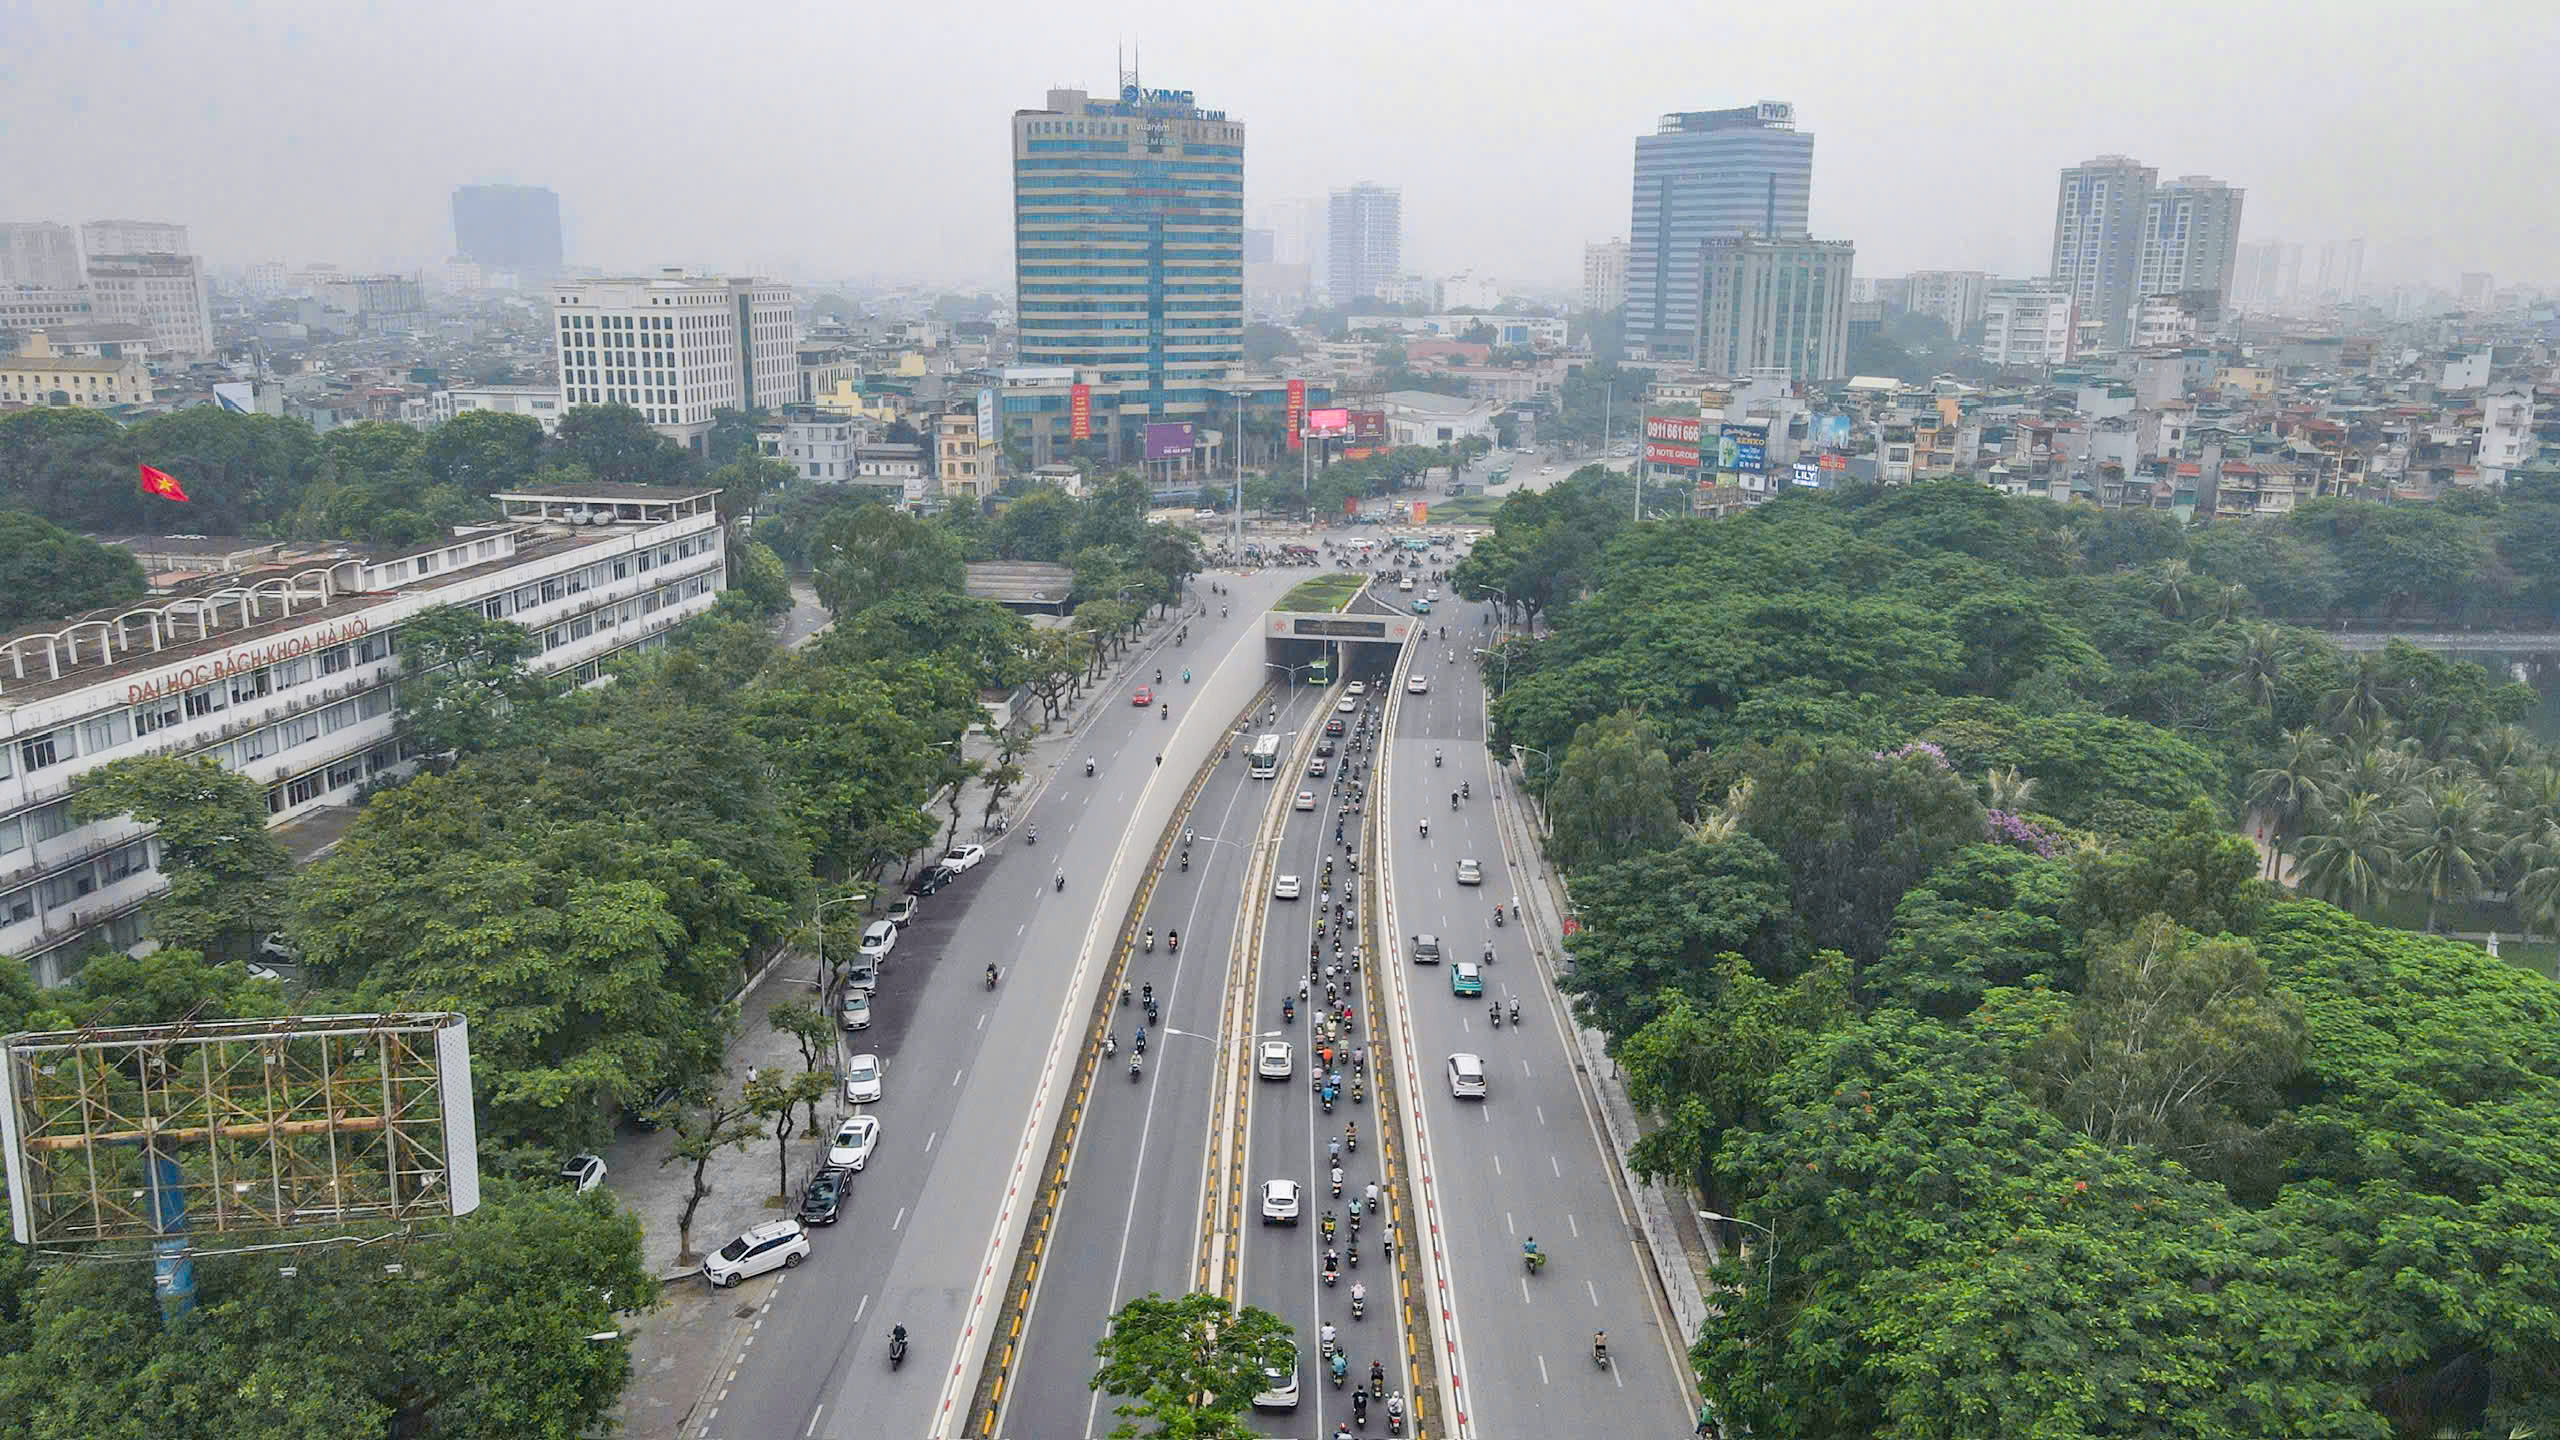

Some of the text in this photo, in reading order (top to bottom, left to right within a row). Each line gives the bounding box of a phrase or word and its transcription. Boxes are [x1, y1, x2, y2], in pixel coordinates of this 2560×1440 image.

[1206, 109, 1225, 120] NAM
[1762, 104, 1788, 118] FWD
[1795, 470, 1816, 481] LILY
[214, 648, 261, 678] BÁCH
[266, 634, 312, 664] KHOA
[317, 622, 337, 647] HÀ
